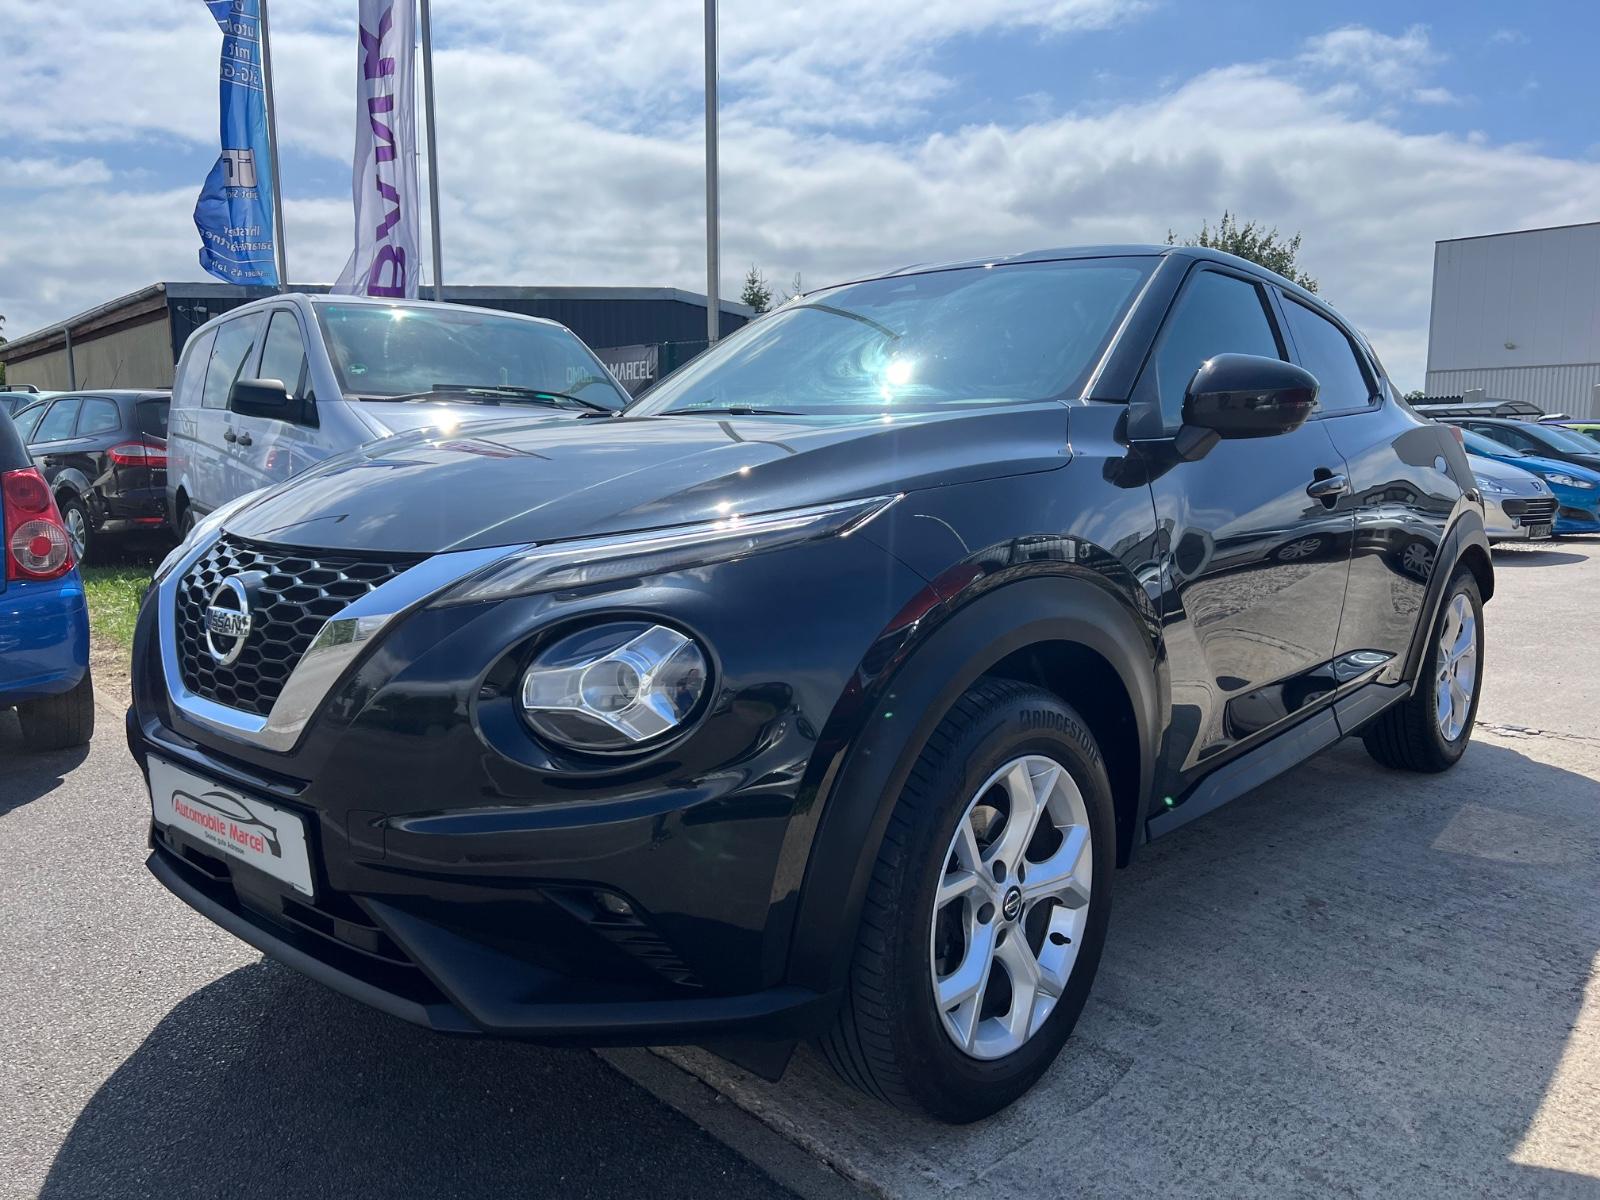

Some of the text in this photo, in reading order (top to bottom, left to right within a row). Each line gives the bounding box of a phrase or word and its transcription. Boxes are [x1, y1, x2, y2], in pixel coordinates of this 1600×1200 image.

[609, 360, 653, 381] MARCEL
[175, 799, 264, 854] Automobile Marcel
